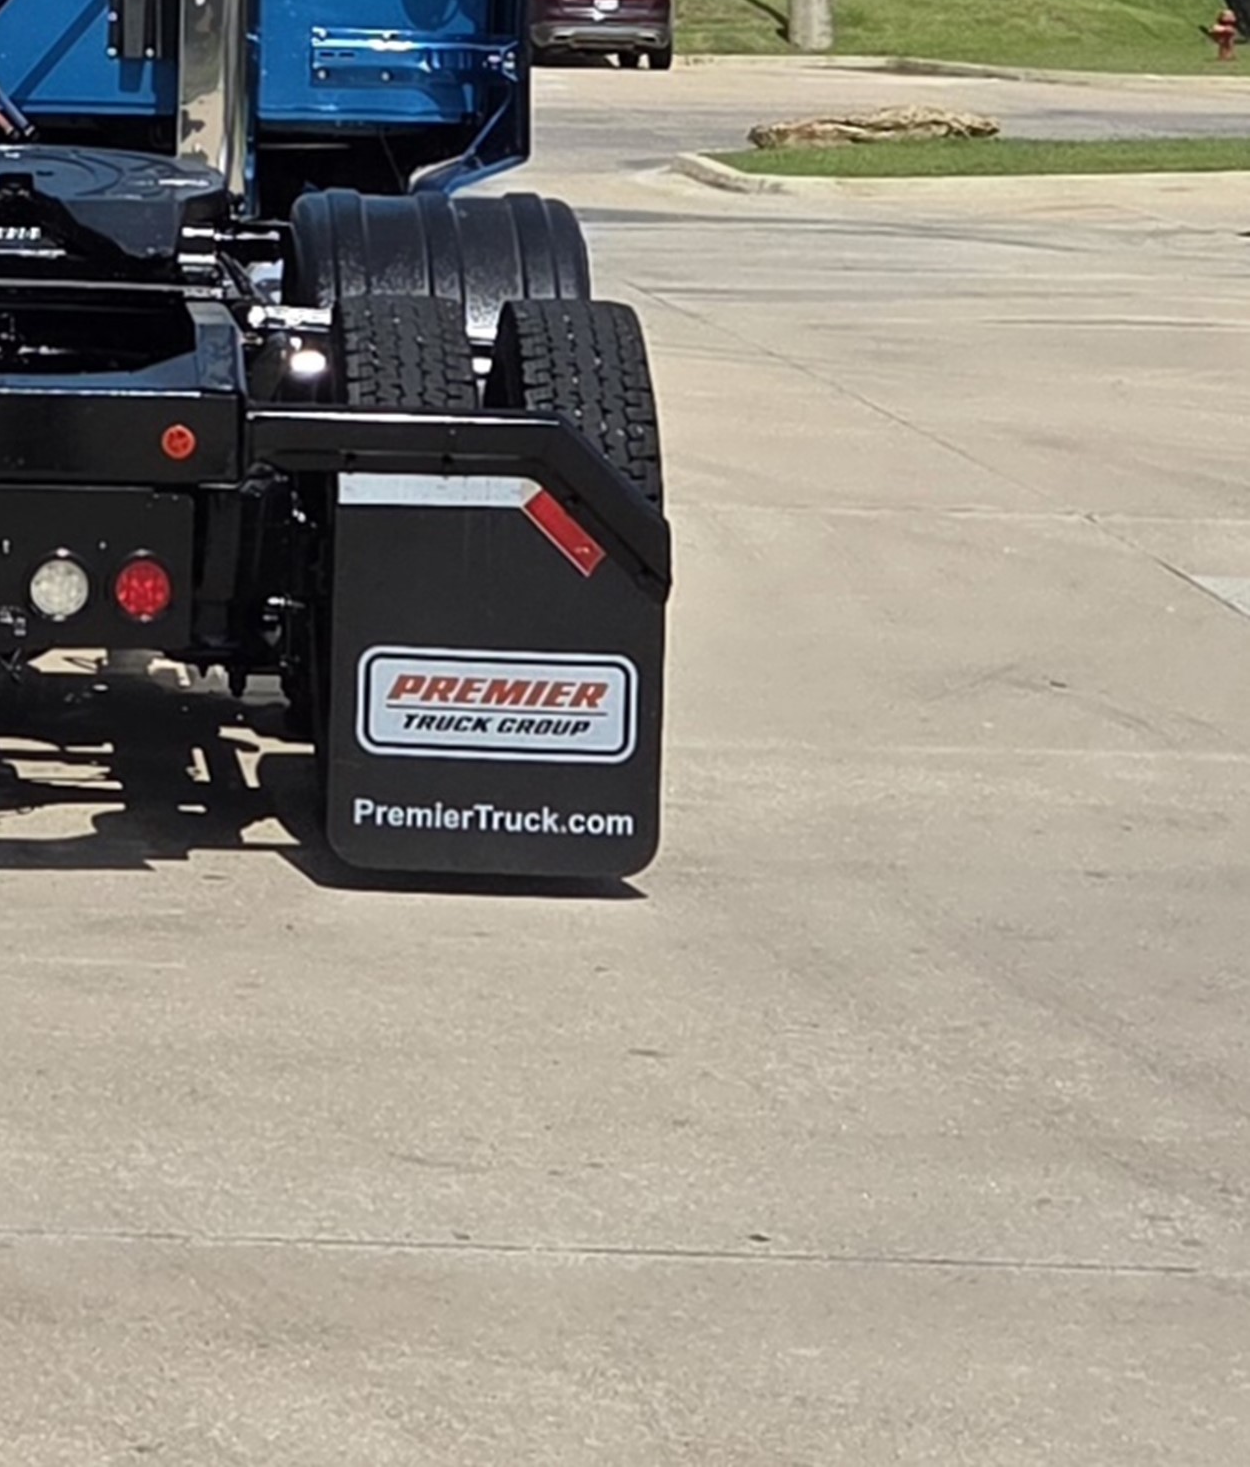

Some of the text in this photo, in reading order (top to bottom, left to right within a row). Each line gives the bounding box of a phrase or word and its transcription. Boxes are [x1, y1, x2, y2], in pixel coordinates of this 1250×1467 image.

[386, 674, 609, 709] PREMIER
[402, 713, 591, 736] TRUCK GROUP
[353, 798, 634, 836] PremierTruck.com
